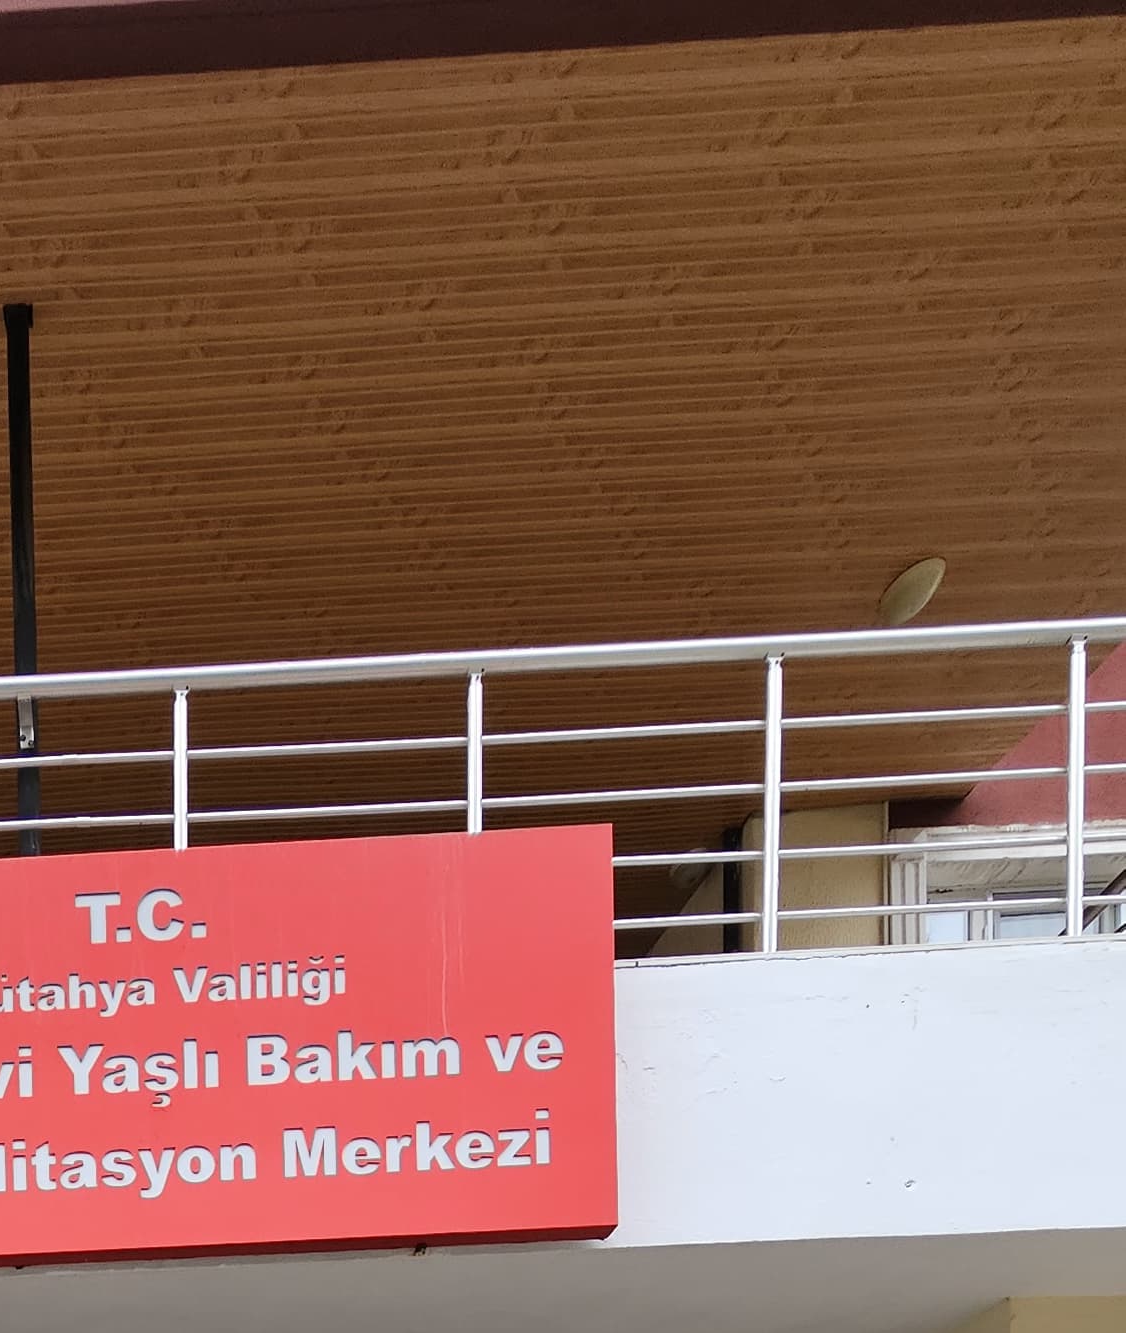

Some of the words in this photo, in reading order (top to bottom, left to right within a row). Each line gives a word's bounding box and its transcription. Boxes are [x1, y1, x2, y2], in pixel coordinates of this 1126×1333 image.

[74, 888, 208, 945] T.C.
[172, 956, 346, 1006] Valiliği
[57, 1040, 221, 1108] Yaşlı
[246, 1031, 461, 1086] Bakım
[485, 1031, 564, 1072] ve
[282, 1108, 551, 1179] Merkezi
